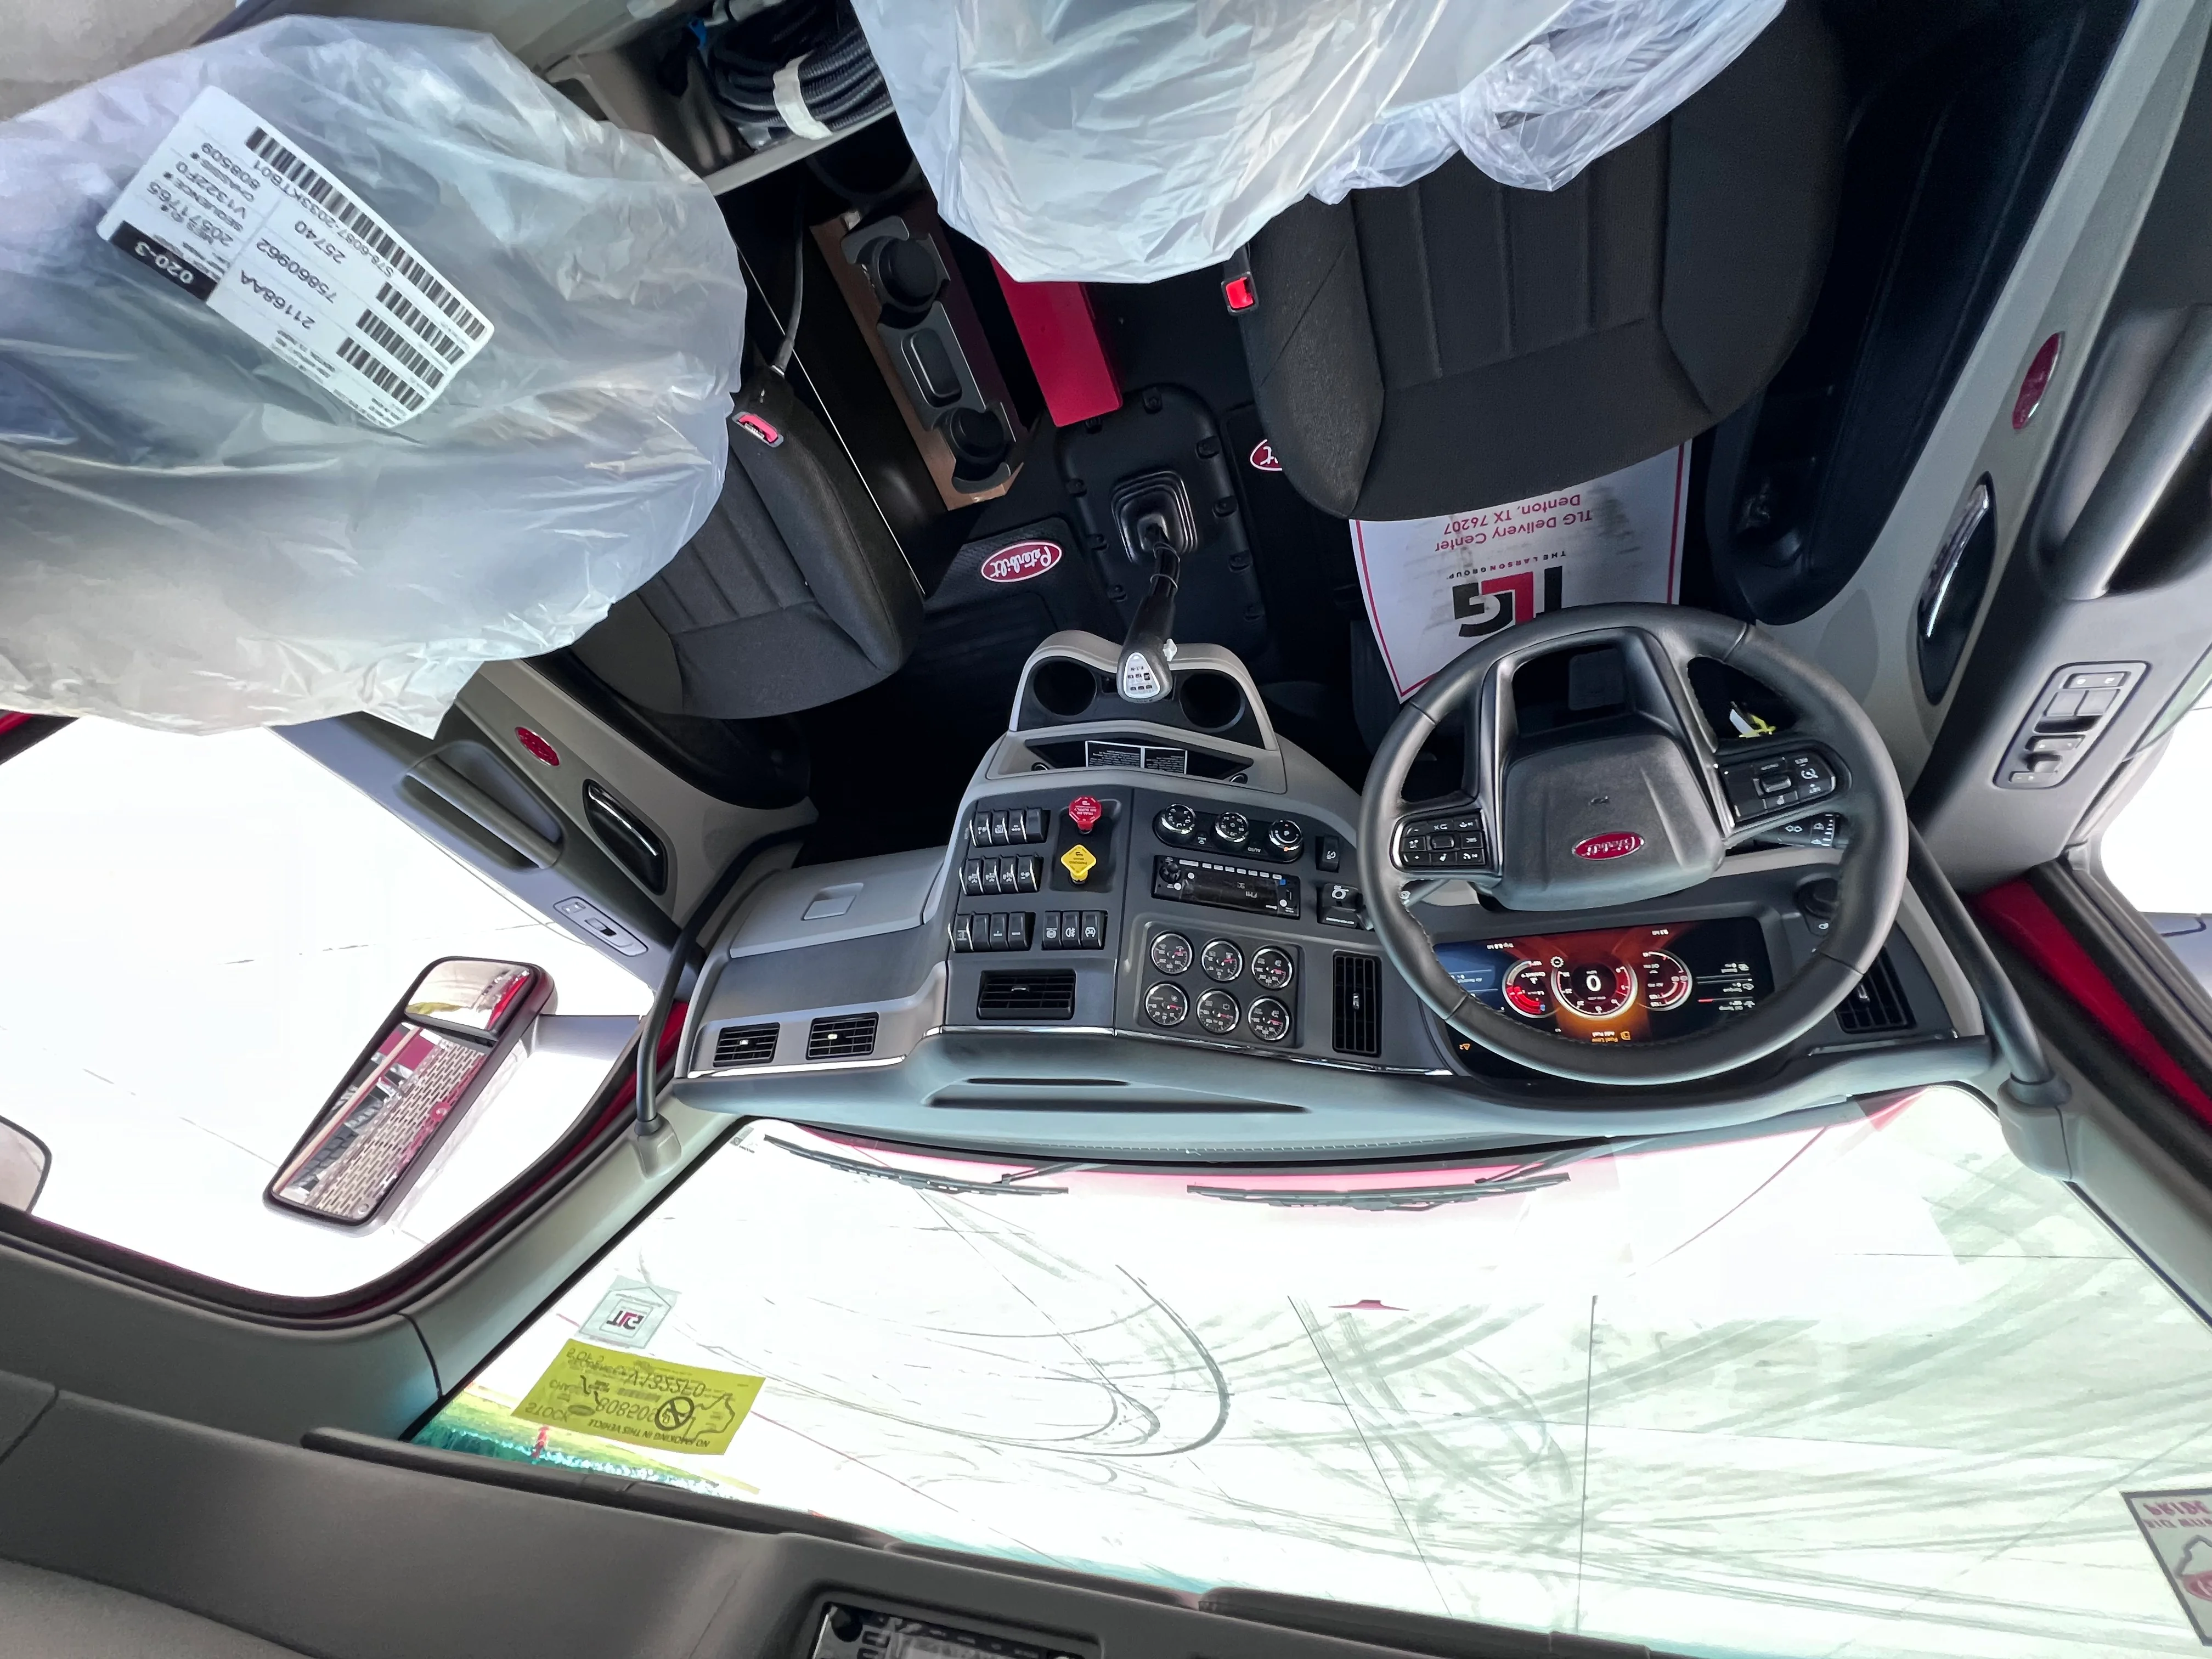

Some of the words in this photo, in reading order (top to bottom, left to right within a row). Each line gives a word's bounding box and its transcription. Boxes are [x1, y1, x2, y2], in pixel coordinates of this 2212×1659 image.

[199, 140, 262, 192] 808509
[173, 159, 250, 220] V1322F0
[199, 157, 256, 204] CHASSIS
[145, 179, 234, 248] 20571765
[172, 176, 245, 234] SEQUENCE
[292, 218, 347, 265] 25740
[133, 238, 196, 286] 020-3
[255, 236, 340, 304] 75860962
[237, 269, 316, 331] 21168AA
[1492, 509, 1512, 523] TX
[1516, 493, 1582, 518] Denton,
[1561, 509, 1592, 526] TLG
[1441, 514, 1488, 535] 76207
[1492, 516, 1558, 539] Delivery
[1435, 532, 1487, 552] Center
[989, 546, 1053, 577] Peterbilt
[1542, 550, 1565, 561] THE
[1585, 974, 1601, 992] 0
[586, 1418, 622, 1434] VEHICLE
[620, 1425, 642, 1438] THIS
[641, 1428, 653, 1440] IN
[695, 1437, 710, 1449] NO
